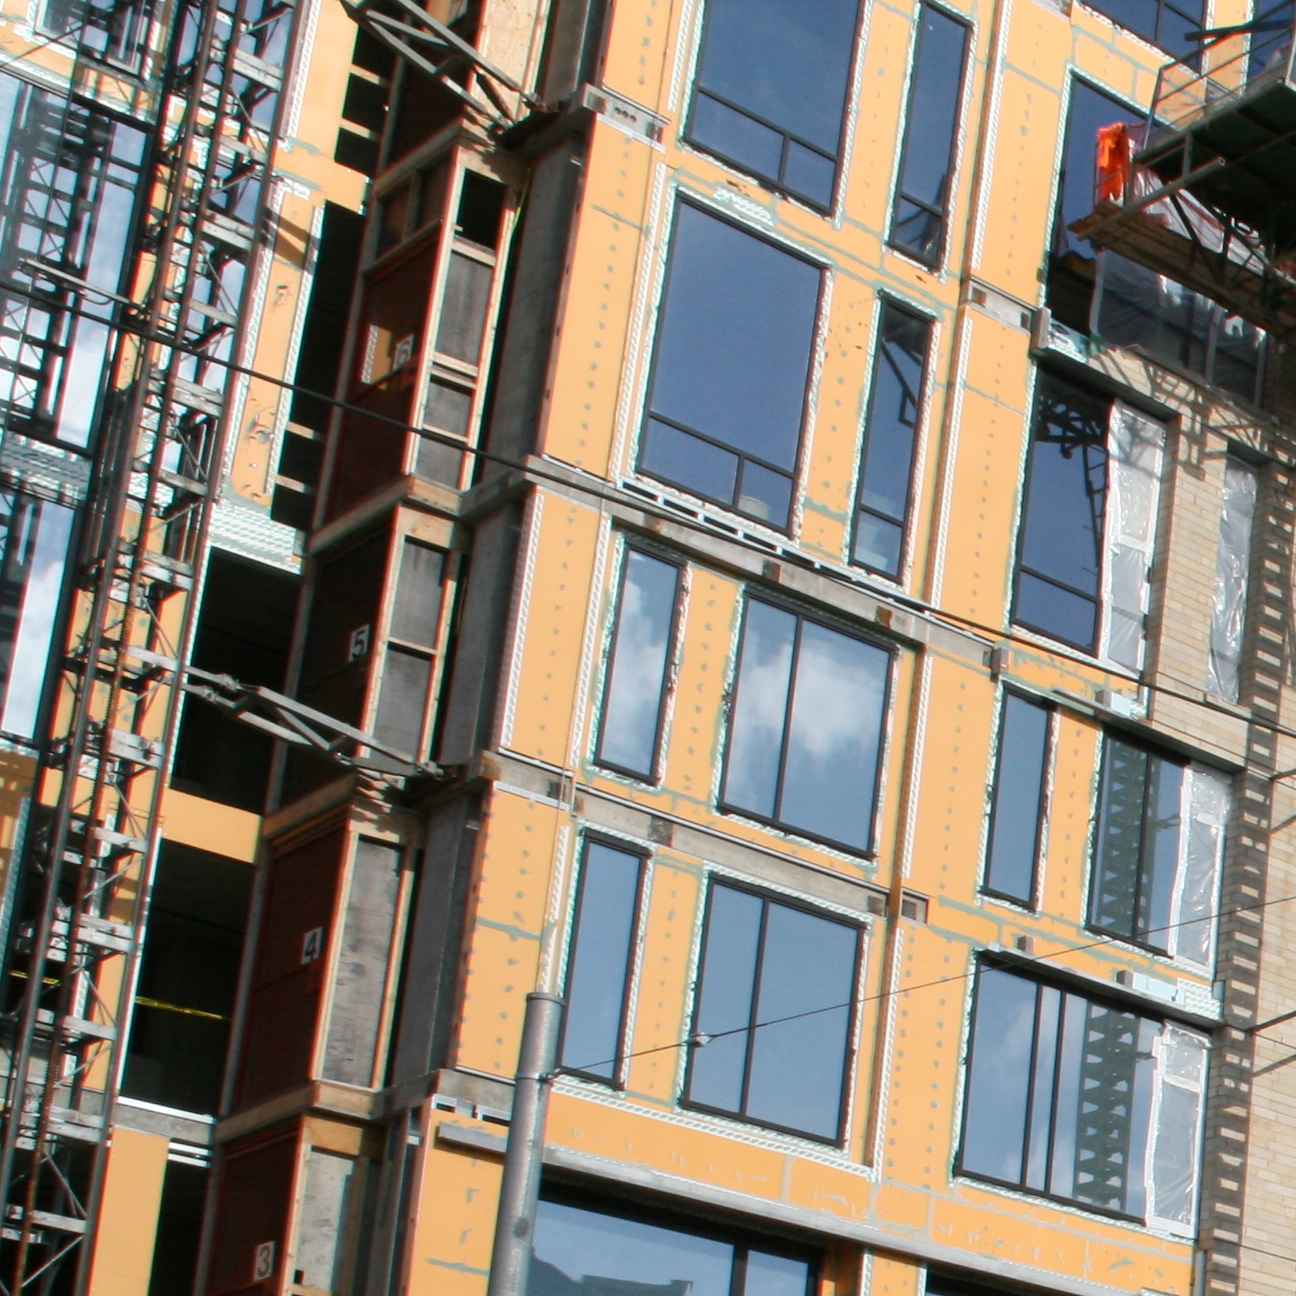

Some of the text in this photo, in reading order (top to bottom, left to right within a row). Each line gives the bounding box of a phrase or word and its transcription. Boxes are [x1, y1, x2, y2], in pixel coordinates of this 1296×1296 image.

[353, 629, 366, 660] 5
[305, 931, 317, 961] 4
[258, 1245, 270, 1277] 3
